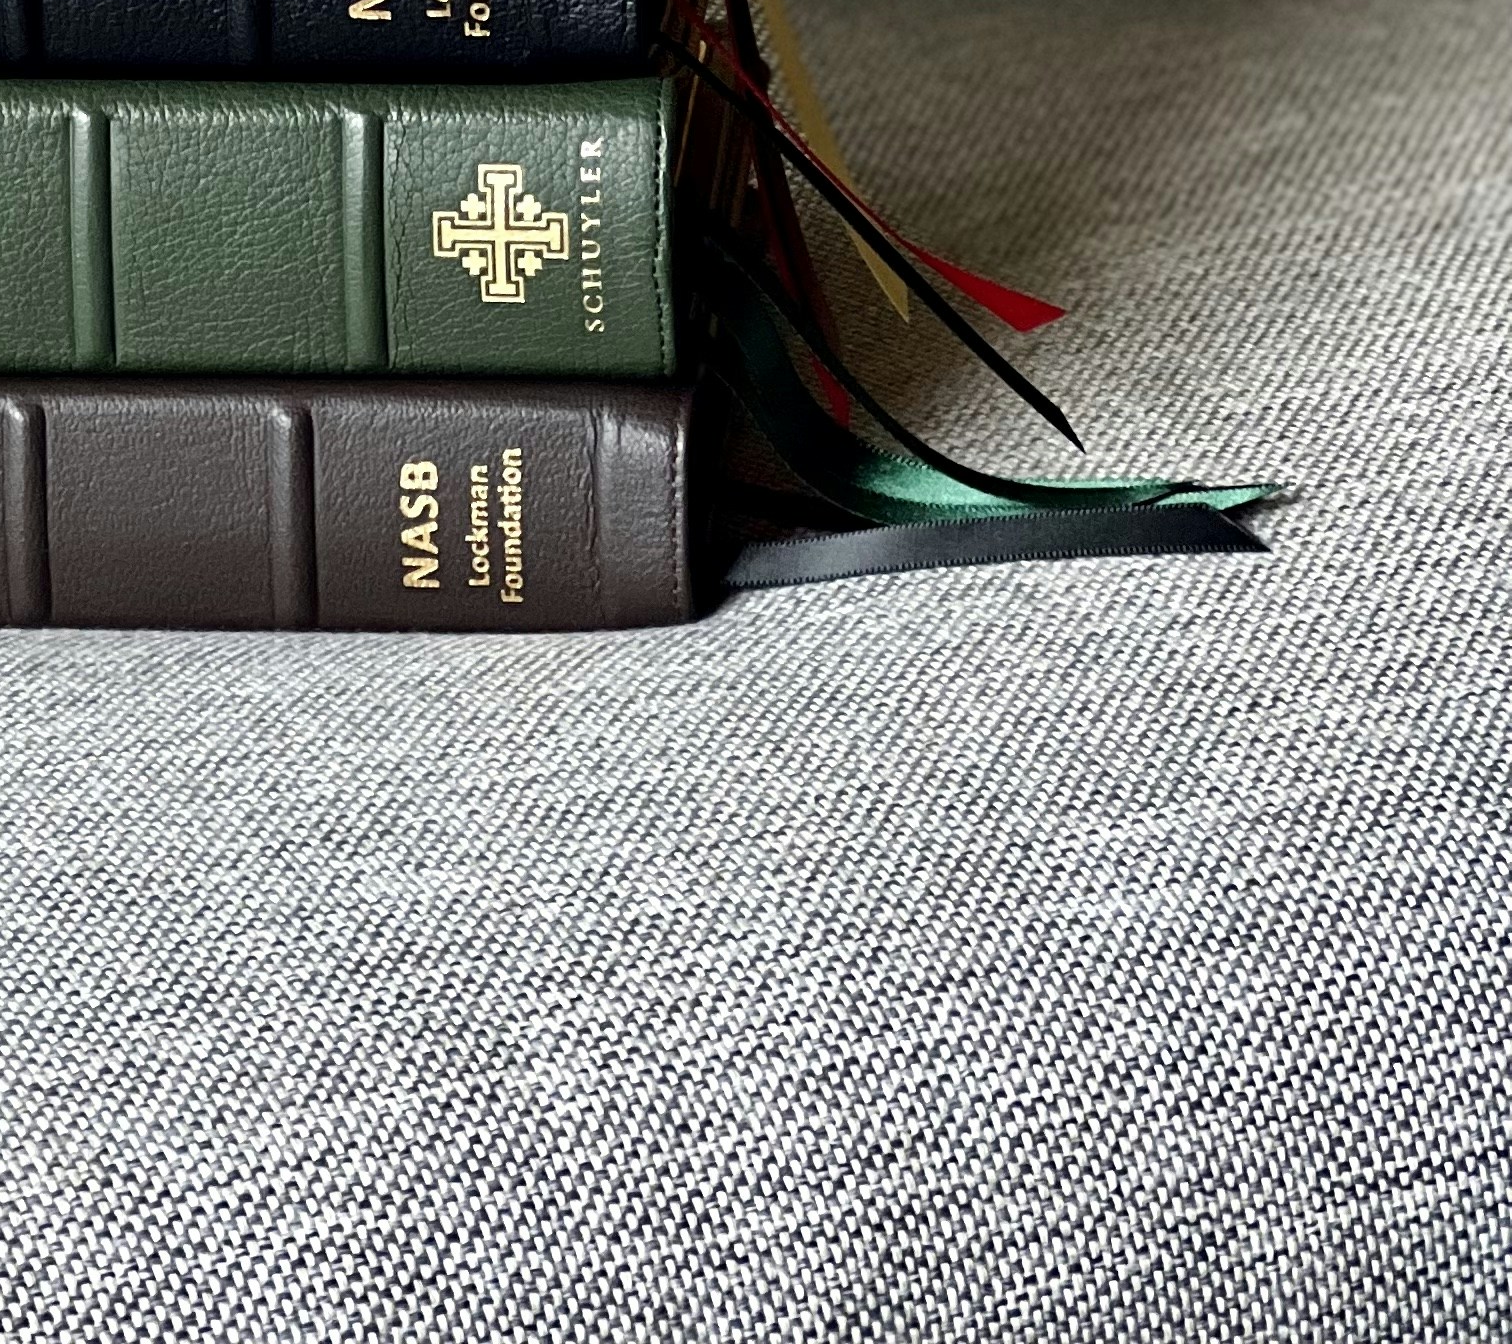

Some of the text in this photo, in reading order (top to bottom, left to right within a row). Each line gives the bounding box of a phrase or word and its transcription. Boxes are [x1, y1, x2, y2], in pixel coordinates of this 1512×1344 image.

[579, 136, 606, 334] SCHUYLER
[399, 460, 440, 588] NASB
[464, 464, 490, 586] Lockman
[496, 447, 524, 603] Foundation
